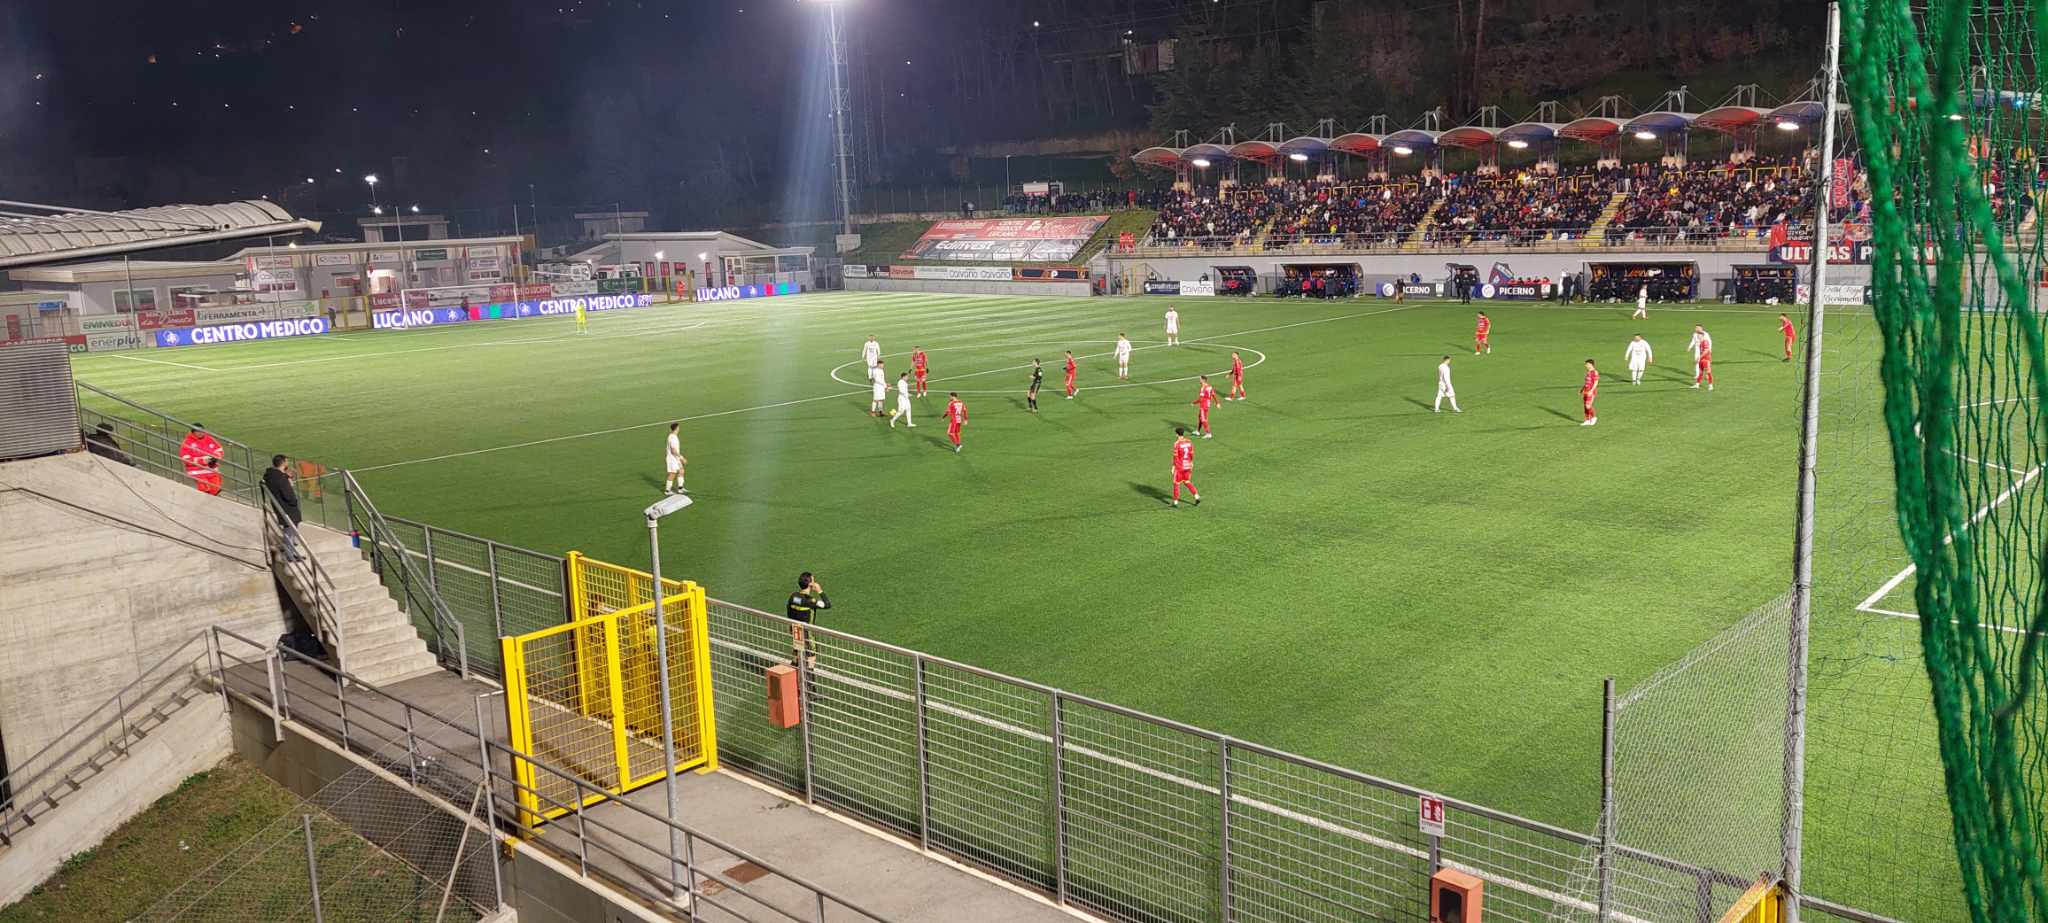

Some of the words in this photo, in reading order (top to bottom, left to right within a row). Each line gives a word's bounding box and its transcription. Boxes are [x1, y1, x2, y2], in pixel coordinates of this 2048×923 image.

[1781, 246, 1850, 260] ULTAS
[696, 286, 740, 302] LUCANO
[1499, 287, 1535, 296] PICERNO
[539, 299, 585, 315] CENTRO
[589, 295, 635, 311] MEDICO
[372, 310, 434, 329] LUCANO
[191, 323, 258, 344] CENTRO
[260, 318, 324, 338] MEDICO
